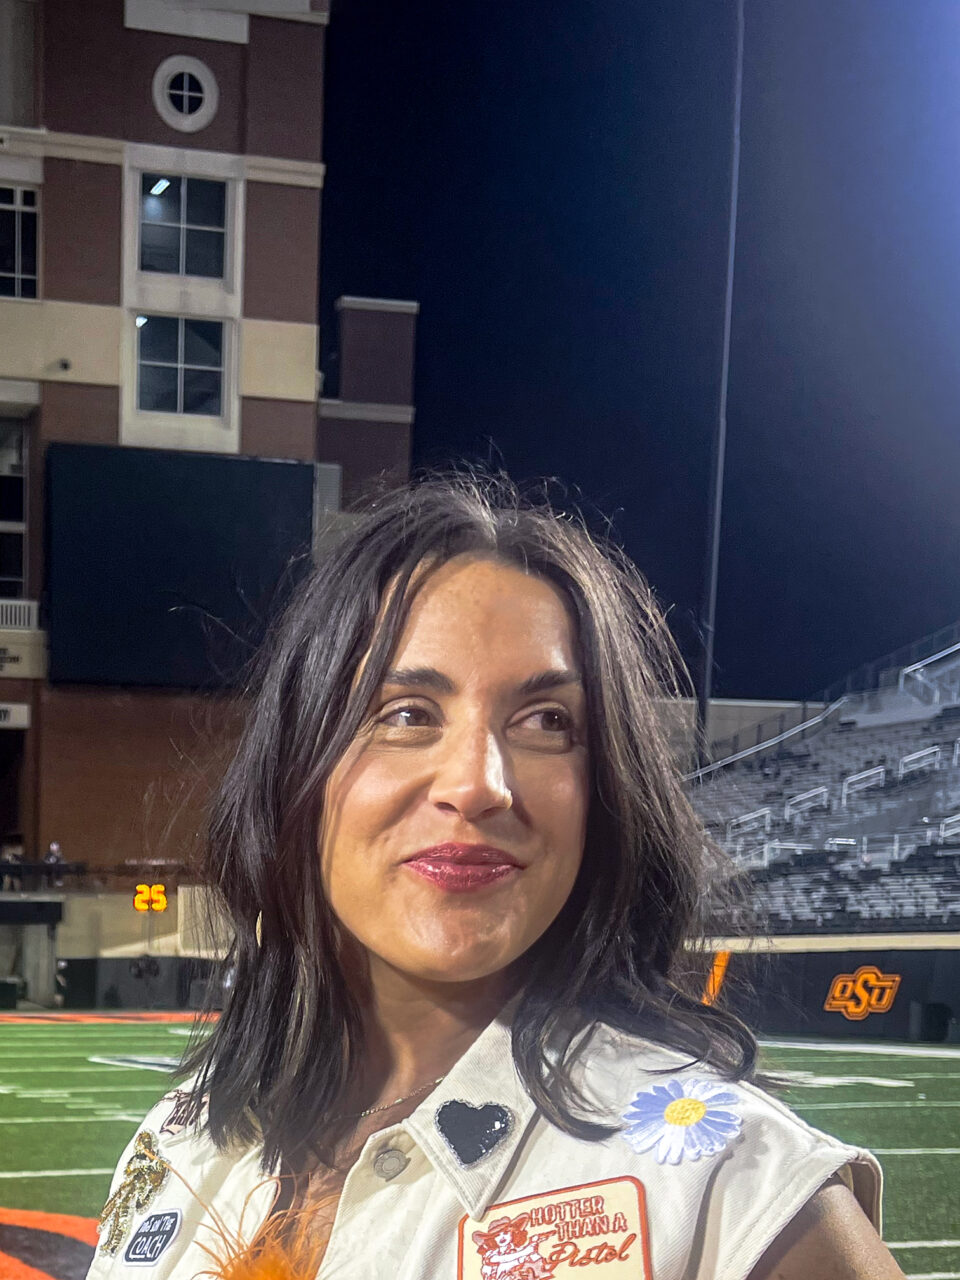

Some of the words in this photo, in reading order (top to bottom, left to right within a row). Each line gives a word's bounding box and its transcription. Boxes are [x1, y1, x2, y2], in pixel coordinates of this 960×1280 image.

[134, 884, 167, 912] 25
[824, 965, 902, 1021] OSU
[529, 1195, 605, 1228] HOTTER
[555, 1213, 609, 1241] THAN
[610, 1212, 628, 1233] A
[128, 1235, 166, 1259] COACH
[543, 1233, 637, 1272] Pistol
